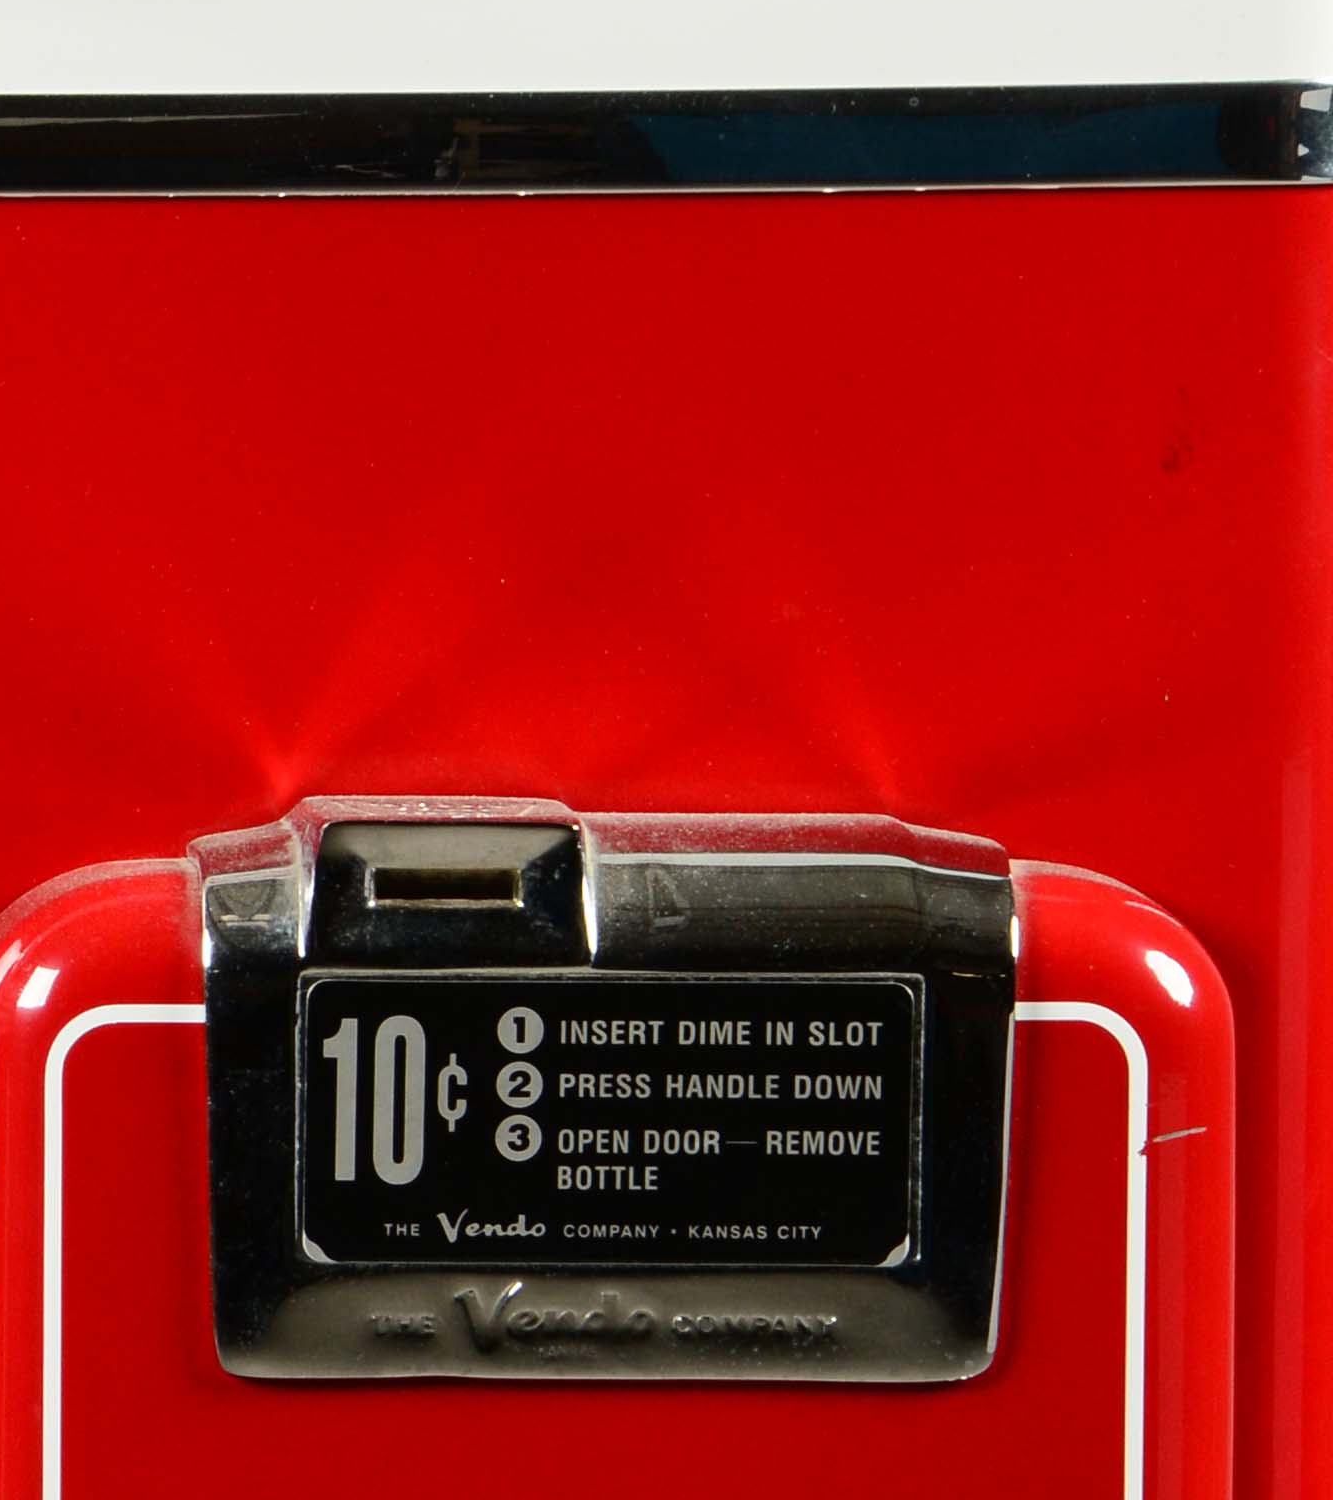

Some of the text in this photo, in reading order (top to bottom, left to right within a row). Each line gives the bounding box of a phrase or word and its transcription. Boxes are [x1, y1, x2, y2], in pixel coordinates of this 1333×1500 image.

[560, 1019, 664, 1045] INSERT
[678, 1020, 751, 1045] DIME
[766, 1021, 794, 1046] IN
[808, 1021, 883, 1047] SLOT
[559, 1073, 651, 1099] PRESS
[666, 1074, 780, 1099] HANDLE
[794, 1074, 882, 1100] DOWN
[558, 1128, 629, 1154] OPEN
[766, 1130, 880, 1156] REMOVE
[557, 1165, 658, 1191] BOTTLE
[384, 1209, 822, 1243] THE Vendo COMPANY KANSAS CITY
[370, 1314, 436, 1338] THE
[453, 1280, 656, 1354] Vendo
[670, 1314, 838, 1338] COMPANY
